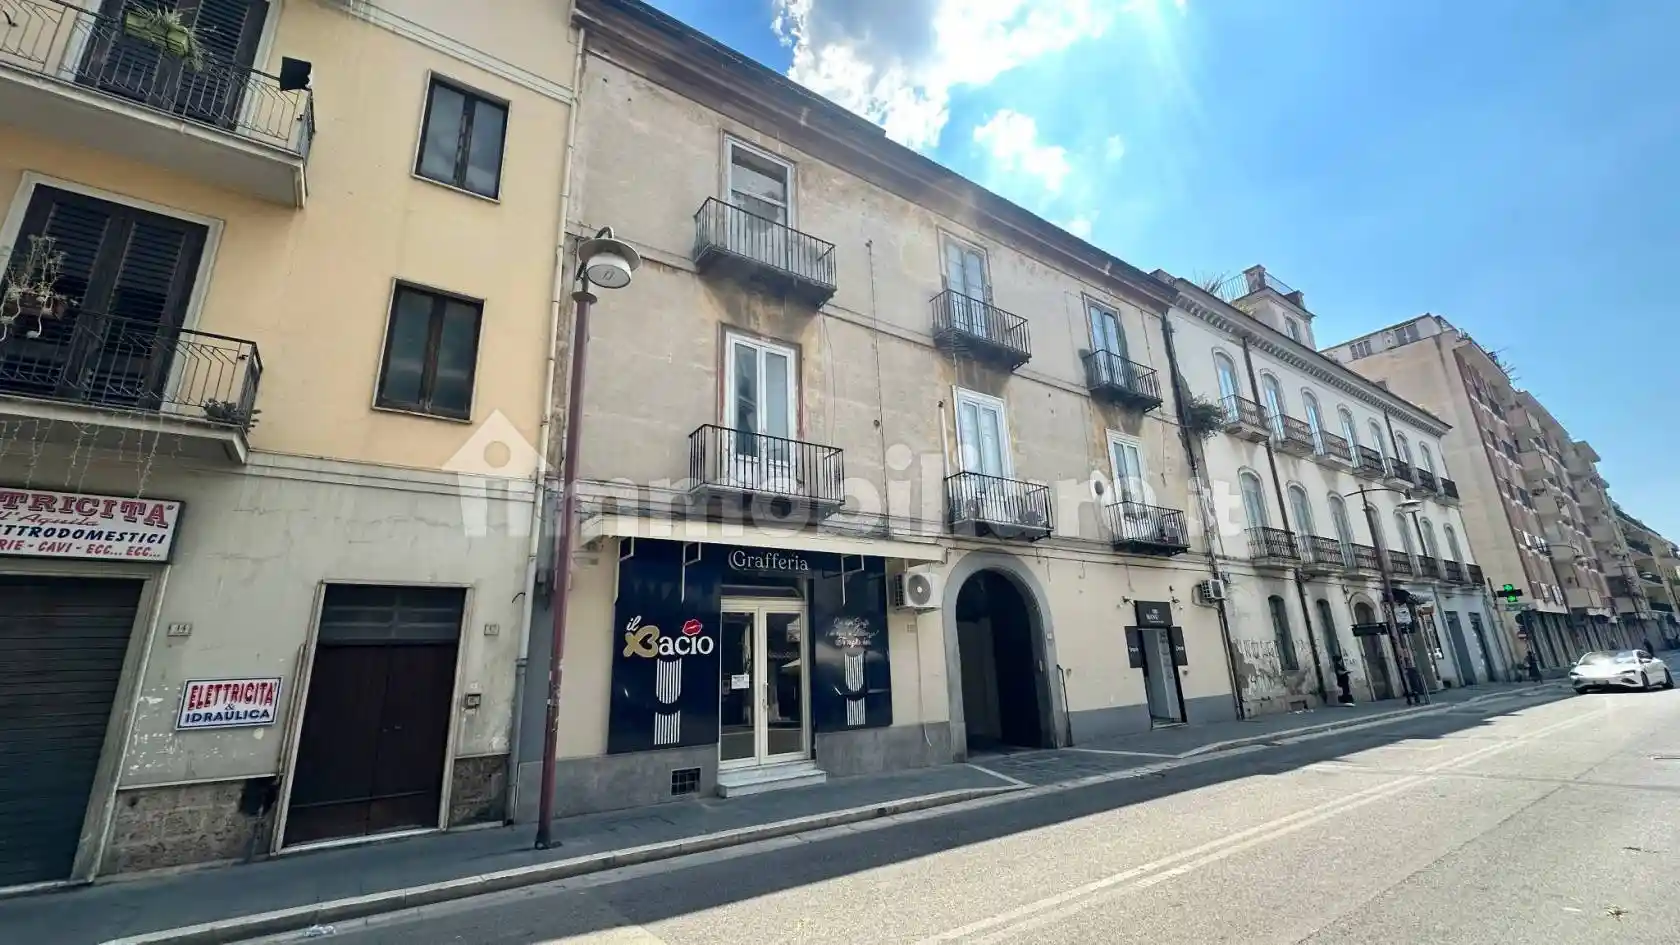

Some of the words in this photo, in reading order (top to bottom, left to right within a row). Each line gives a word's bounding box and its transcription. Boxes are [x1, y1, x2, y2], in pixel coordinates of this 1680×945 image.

[0, 524, 167, 545] TTRODOMESTICI
[38, 540, 73, 553] CAVI
[728, 550, 809, 571] Grafferia
[224, 703, 235, 711] &
[184, 708, 270, 723] IDRAULICA
